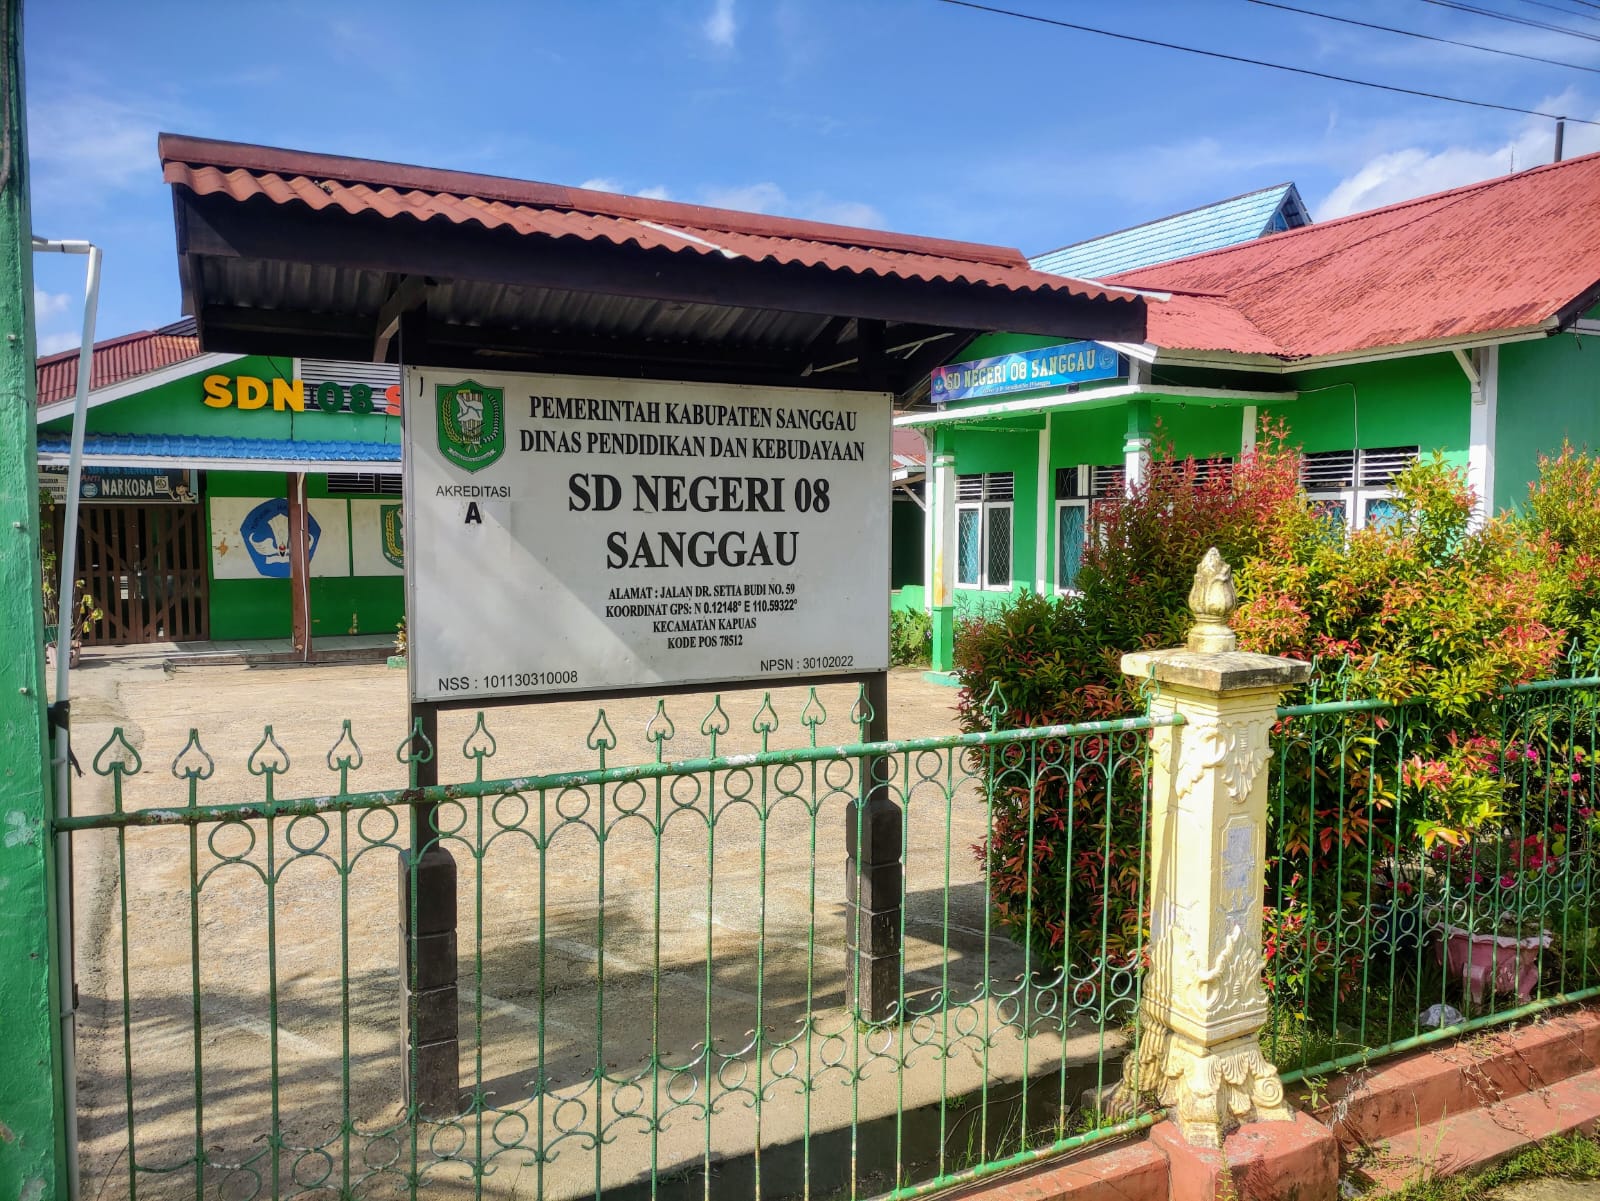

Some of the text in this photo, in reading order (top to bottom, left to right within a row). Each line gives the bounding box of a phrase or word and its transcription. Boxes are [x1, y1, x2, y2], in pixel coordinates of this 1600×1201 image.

[945, 371, 960, 391] SD
[964, 364, 1006, 387] NEGERI
[1010, 361, 1027, 382] 08
[1031, 349, 1096, 378] SANGGAU
[203, 374, 305, 412] SDN
[316, 381, 375, 415] 08
[528, 395, 858, 432] PEMERINTAH KABUPATEN SANGGAU
[519, 429, 865, 462] DINAS PENDIDIKAN DAN KEBUDAYAAN
[101, 478, 154, 497] NARKOBA
[435, 485, 511, 498] AKREDITASI
[568, 473, 831, 513] SD NEGERI 08
[464, 501, 482, 524] A
[607, 531, 800, 569] SANGGAU
[608, 586, 653, 600] ALAMAT
[660, 585, 693, 598] JALAN
[695, 585, 712, 598] DR.
[713, 584, 742, 597] SETIA
[744, 583, 767, 596] BUDI
[768, 583, 785, 596] NO.
[785, 583, 796, 595] 59
[605, 603, 668, 618] KOORDINAT
[669, 602, 692, 616] GPS:
[694, 602, 702, 615] N
[744, 600, 751, 612] E
[652, 617, 757, 633] KECAMATAN KAPUAS
[667, 634, 744, 649] KODE POS 78512
[760, 658, 794, 672] NPSN
[802, 654, 855, 670] 30102022
[438, 676, 470, 692] NSS
[483, 670, 578, 689] 101130310008
